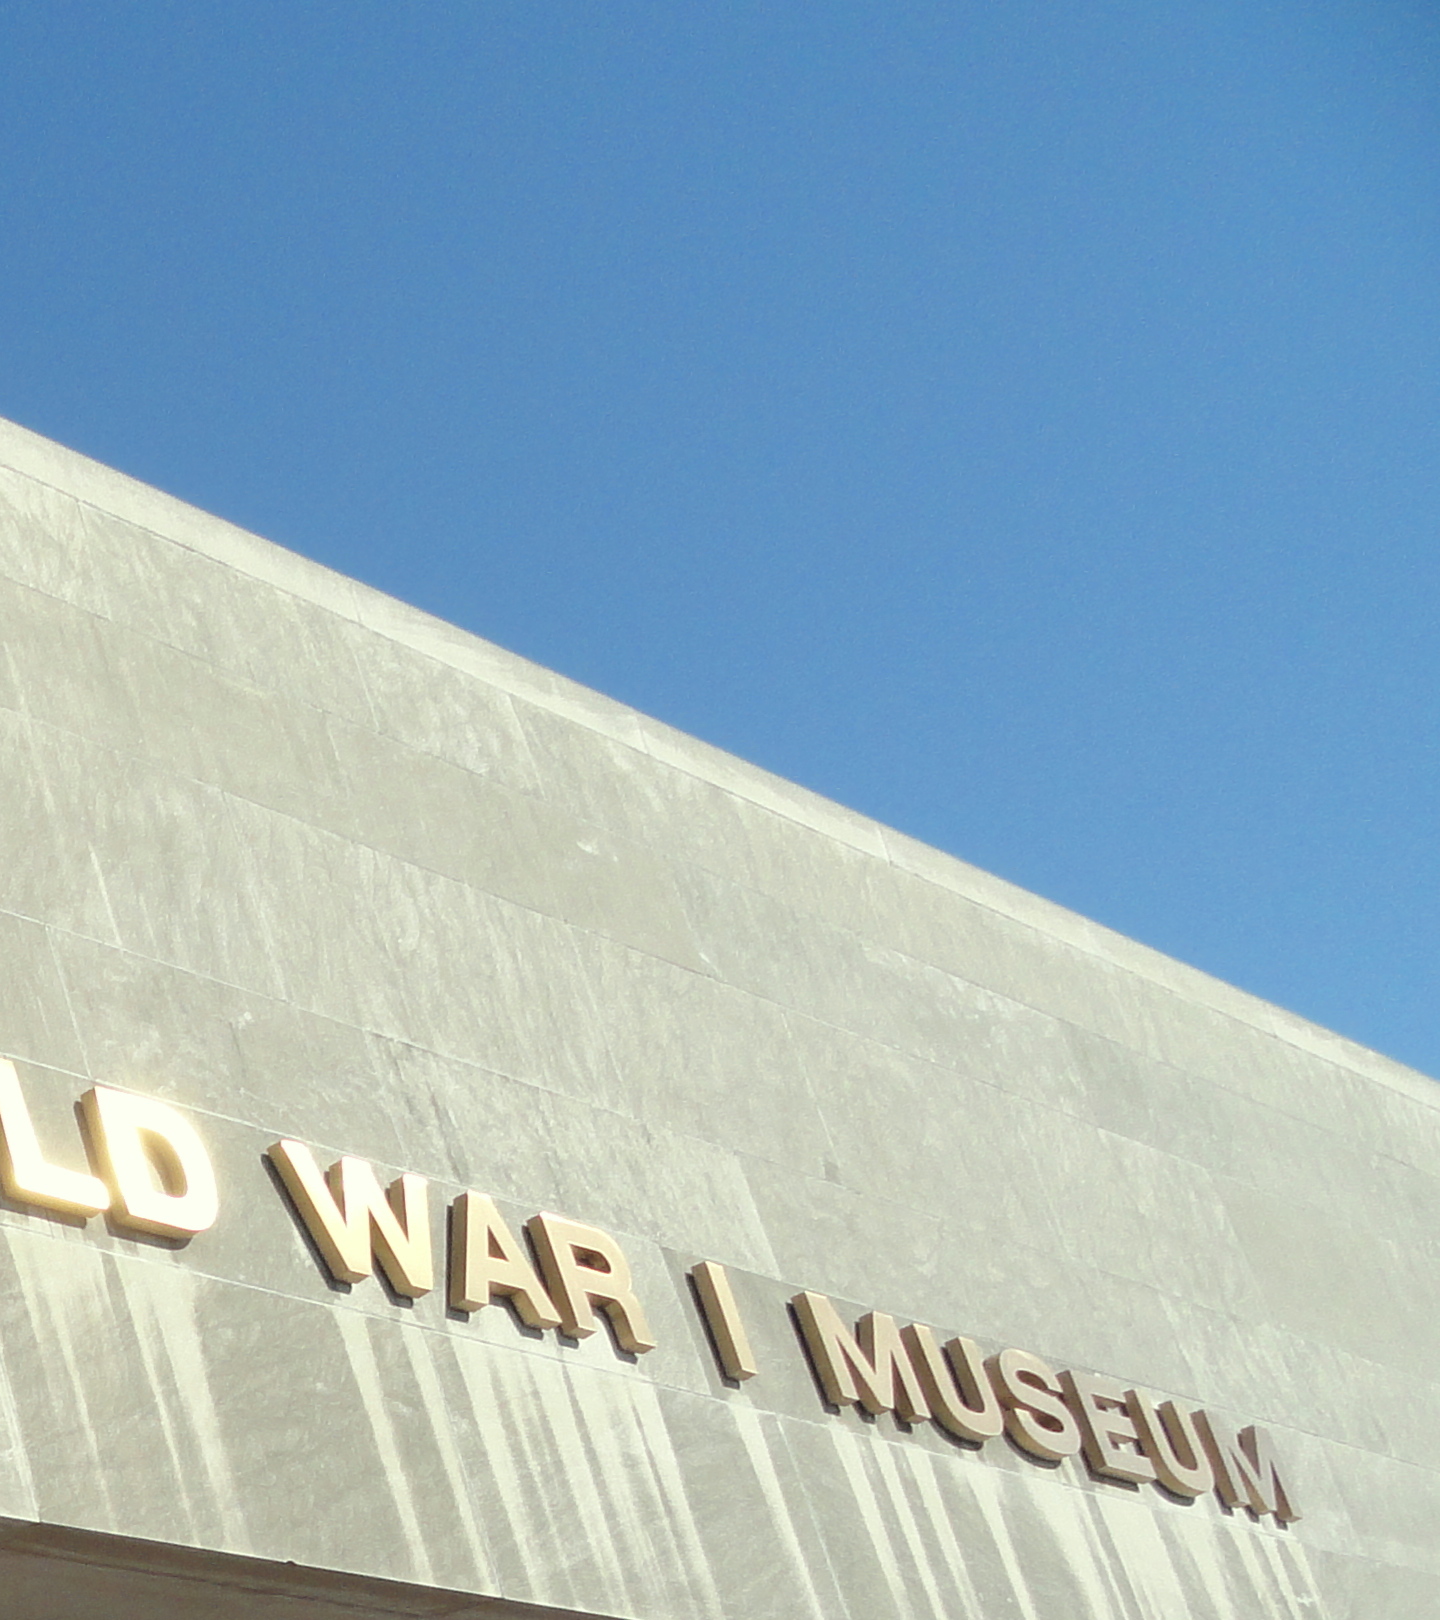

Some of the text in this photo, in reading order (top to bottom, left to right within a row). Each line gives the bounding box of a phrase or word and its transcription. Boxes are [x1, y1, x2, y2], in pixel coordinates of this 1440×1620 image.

[268, 1137, 657, 1356] WAR
[691, 1260, 759, 1381] I
[791, 1289, 1303, 1524] MUSEUM
